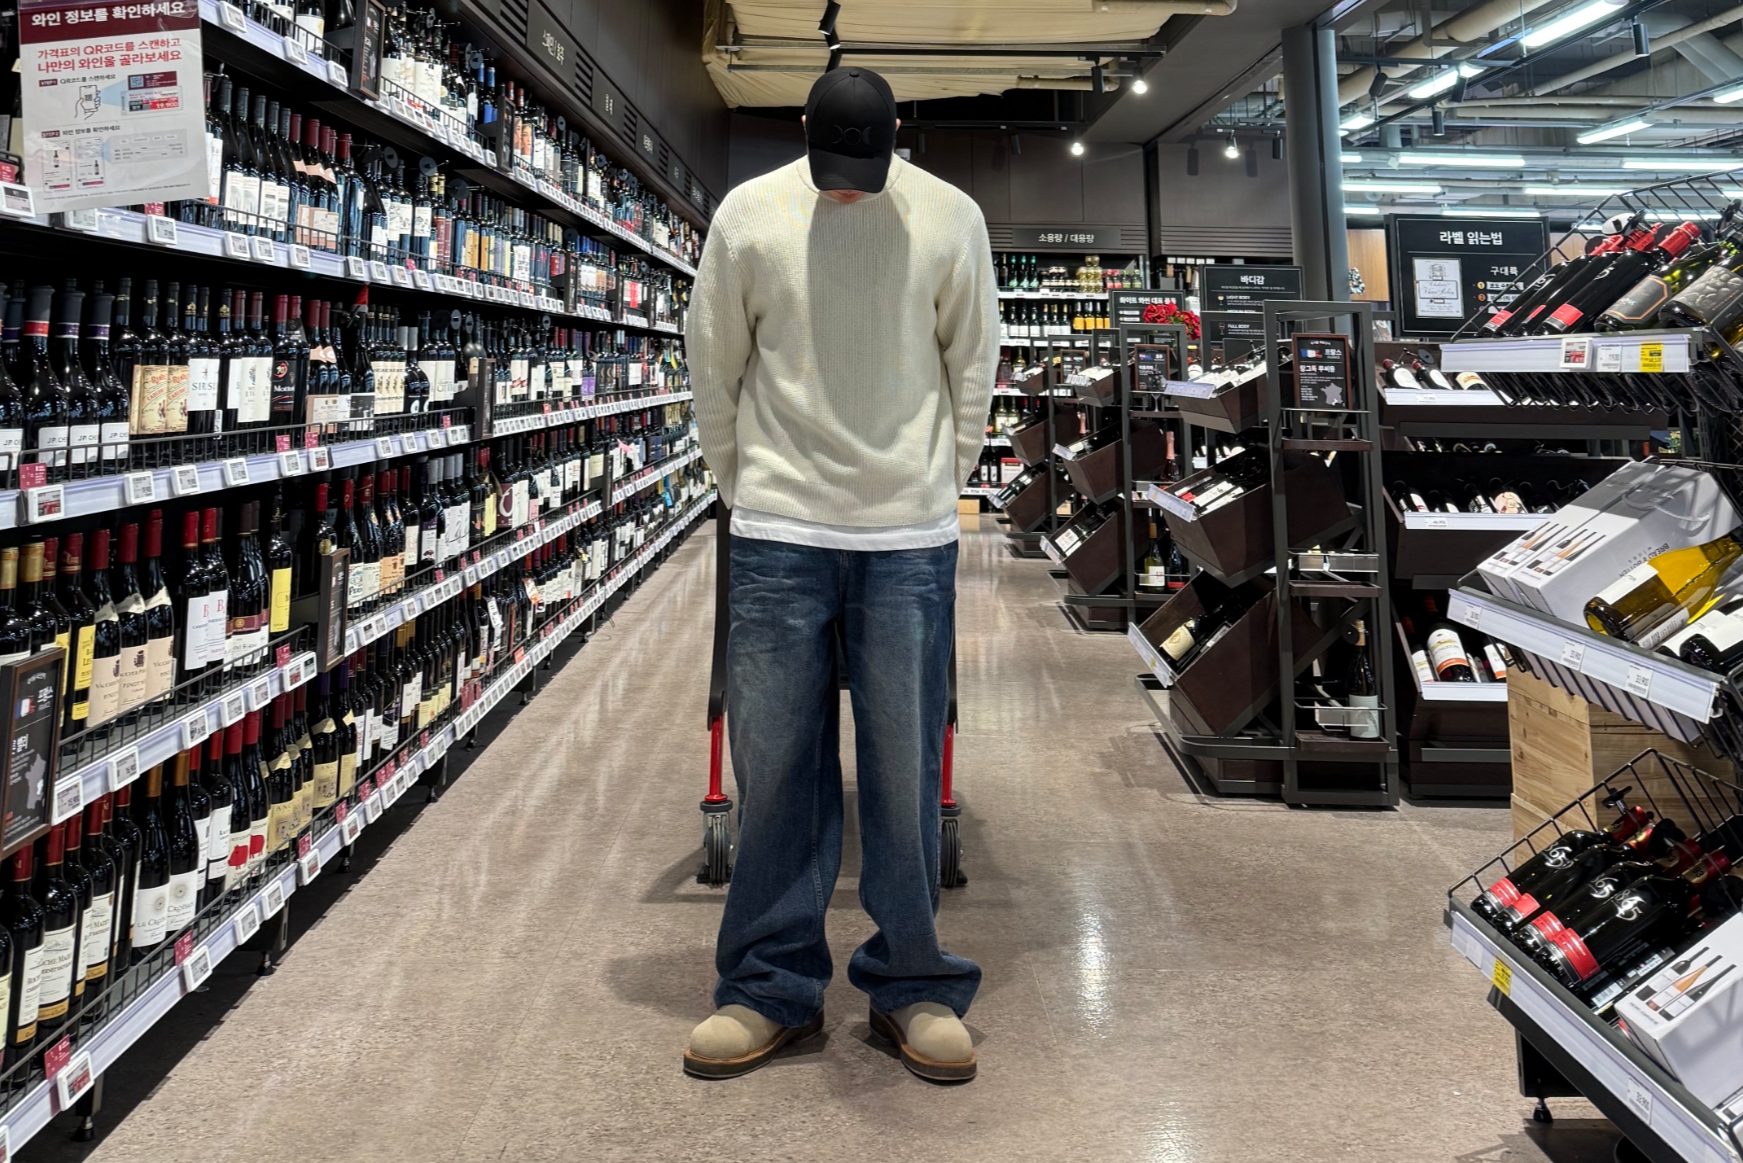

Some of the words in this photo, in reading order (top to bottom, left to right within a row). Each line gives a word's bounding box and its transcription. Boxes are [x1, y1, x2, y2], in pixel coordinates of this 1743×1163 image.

[31, 12, 61, 28] 와인
[64, 8, 109, 25] 정보를
[112, 1, 186, 20] 확인하세요
[37, 46, 81, 60] 가격표의
[83, 42, 135, 56] QR코드를
[138, 38, 182, 51] 스캔하고
[37, 59, 76, 74] 나만의
[78, 55, 116, 70] 와인을
[119, 50, 182, 67] 골라보세요
[1038, 233, 1063, 243] 소용량
[1070, 234, 1095, 244] 대용량
[1439, 231, 1465, 245] 라벨
[1467, 231, 1503, 246] 읽는법
[1490, 266, 1519, 276] 구대륙
[1240, 275, 1265, 285] 바디감
